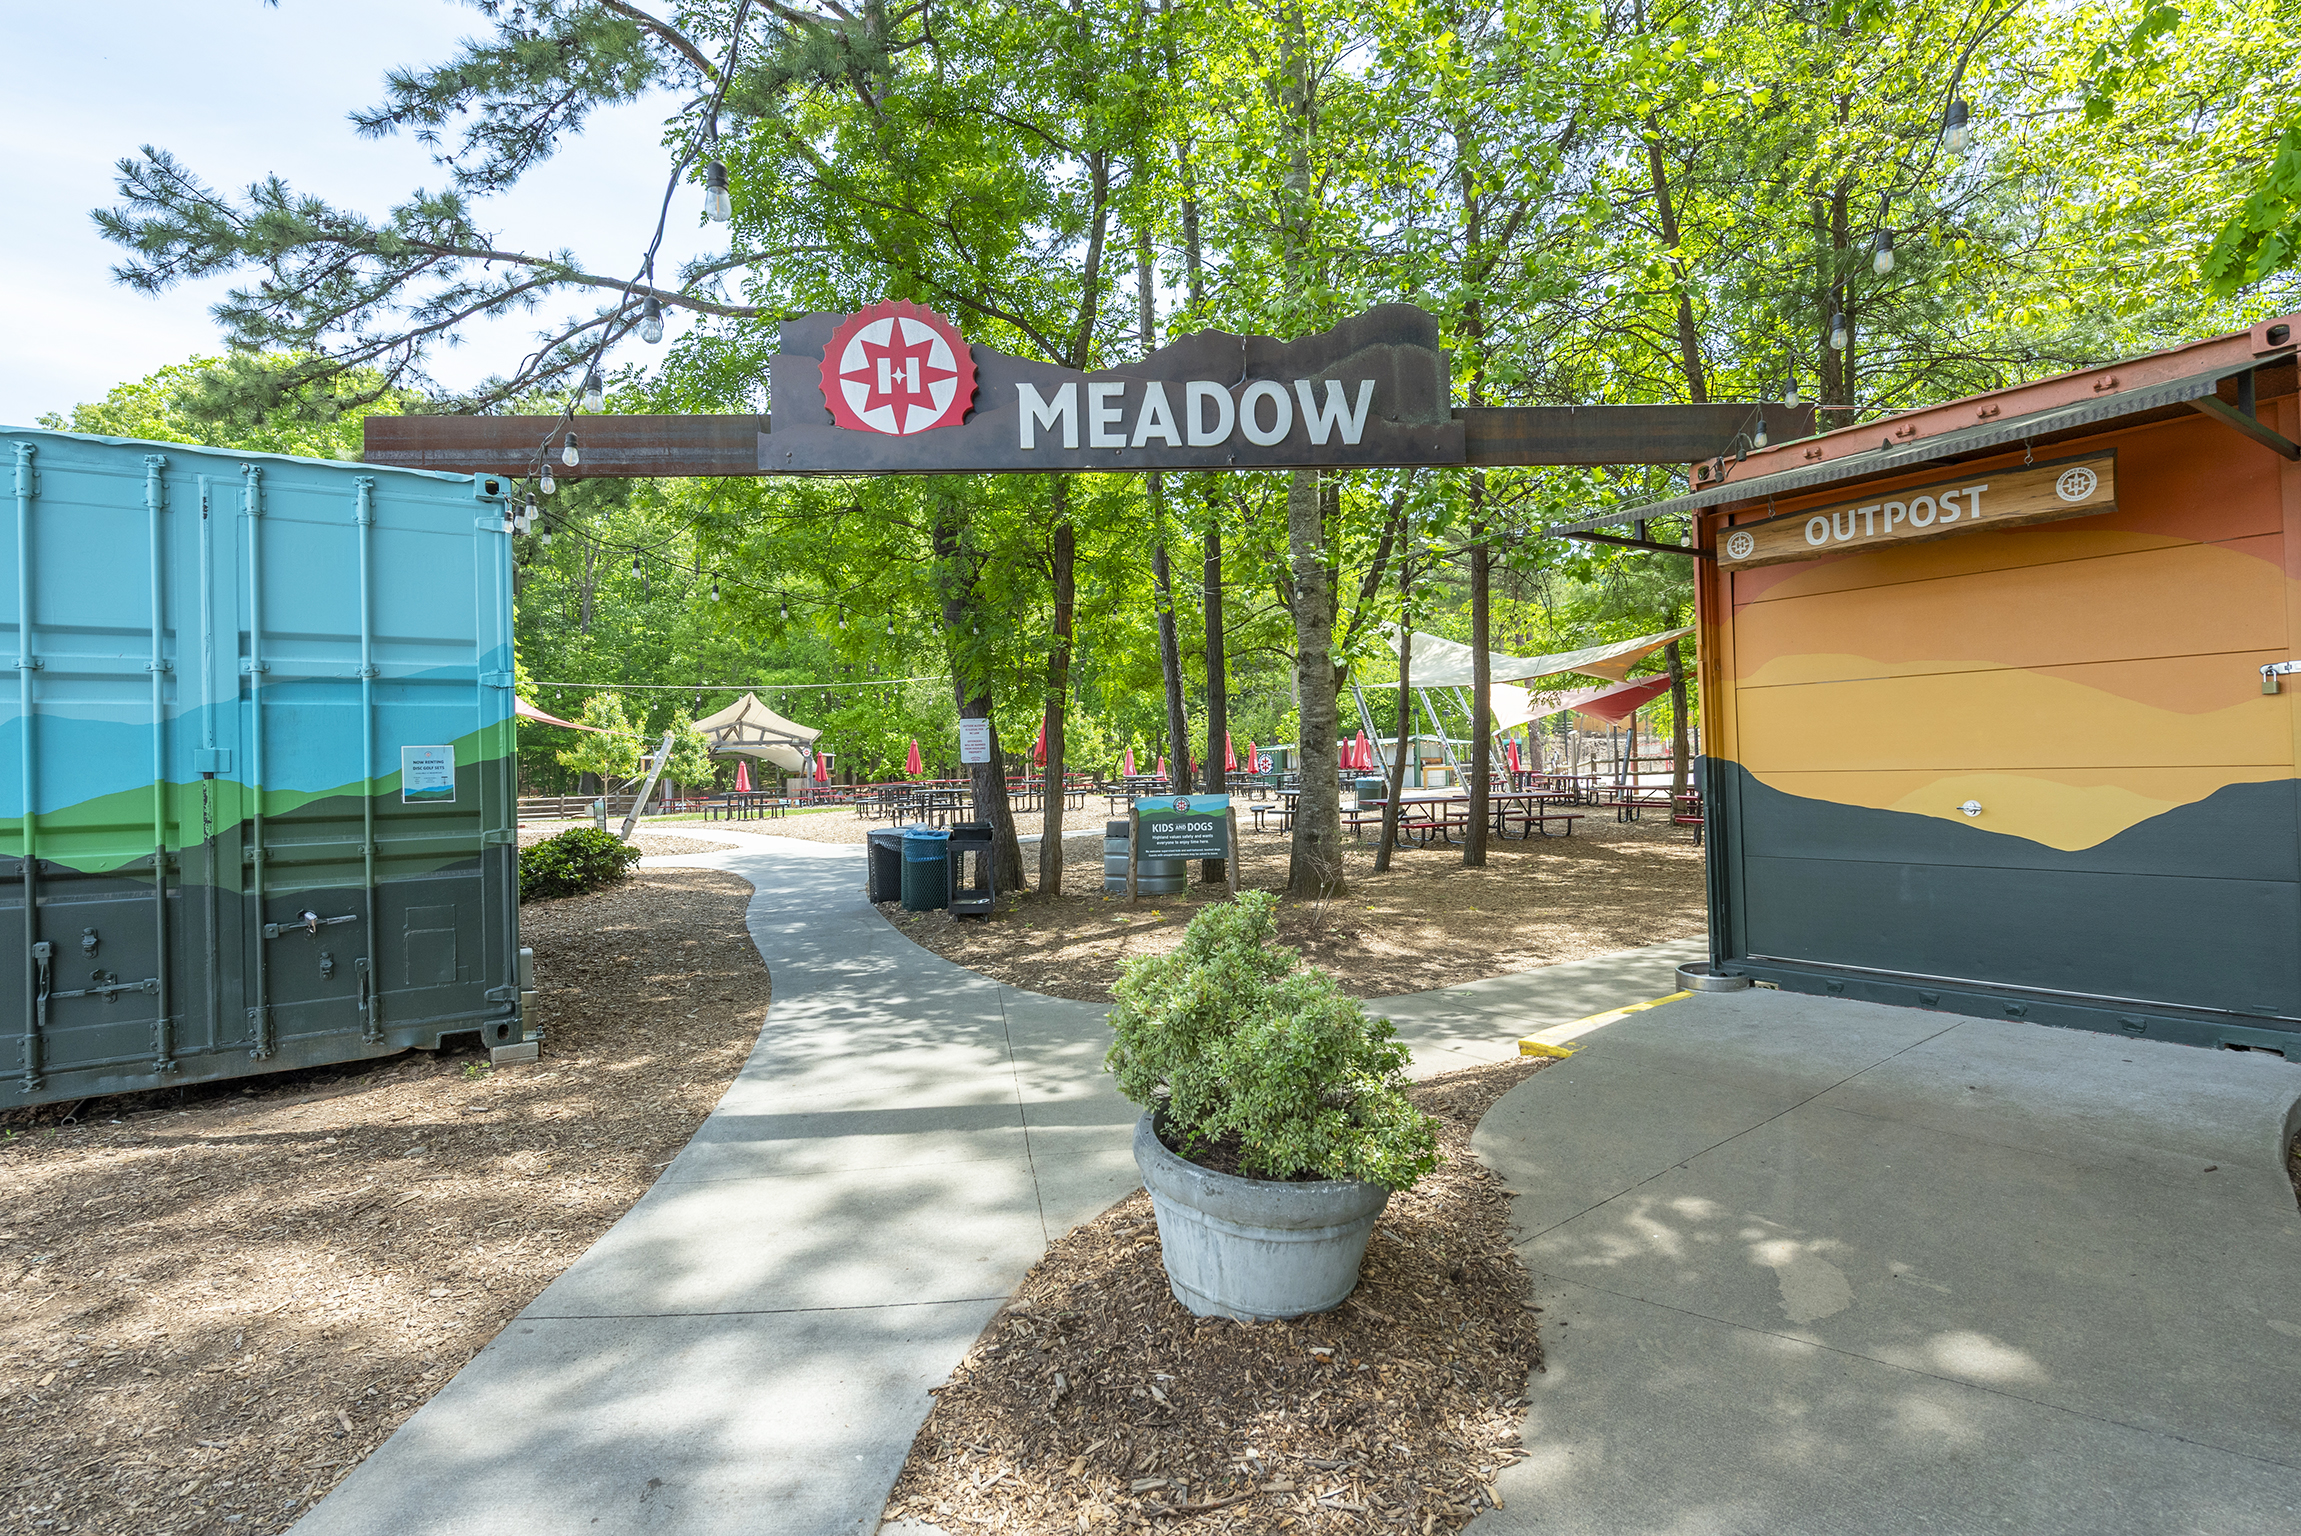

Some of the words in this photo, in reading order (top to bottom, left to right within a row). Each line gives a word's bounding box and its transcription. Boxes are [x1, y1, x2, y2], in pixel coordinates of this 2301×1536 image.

[1016, 380, 1376, 450] MEADOW
[1804, 484, 1989, 546] OUTPOST
[1152, 823, 1174, 832] KIDS
[1187, 822, 1213, 832] DOGS
